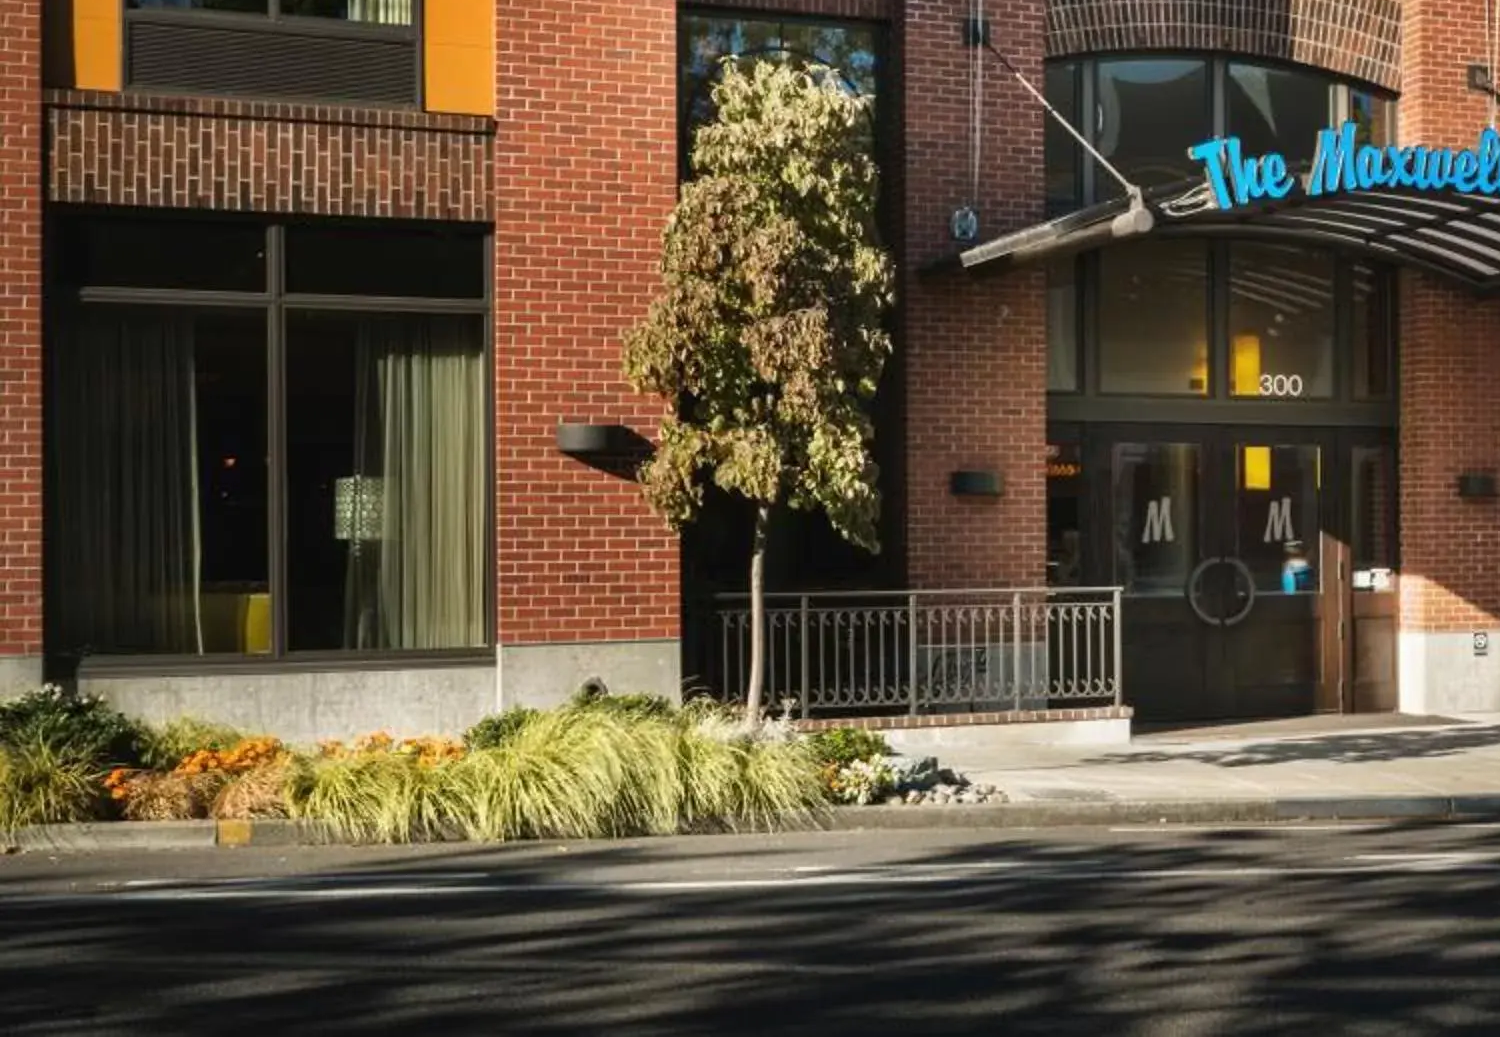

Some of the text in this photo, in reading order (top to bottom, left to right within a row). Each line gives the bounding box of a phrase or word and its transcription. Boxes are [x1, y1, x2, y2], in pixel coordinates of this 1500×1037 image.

[1188, 137, 1294, 210] The
[1259, 373, 1303, 396] 300
[1142, 496, 1174, 543] M
[1263, 497, 1294, 543] M
